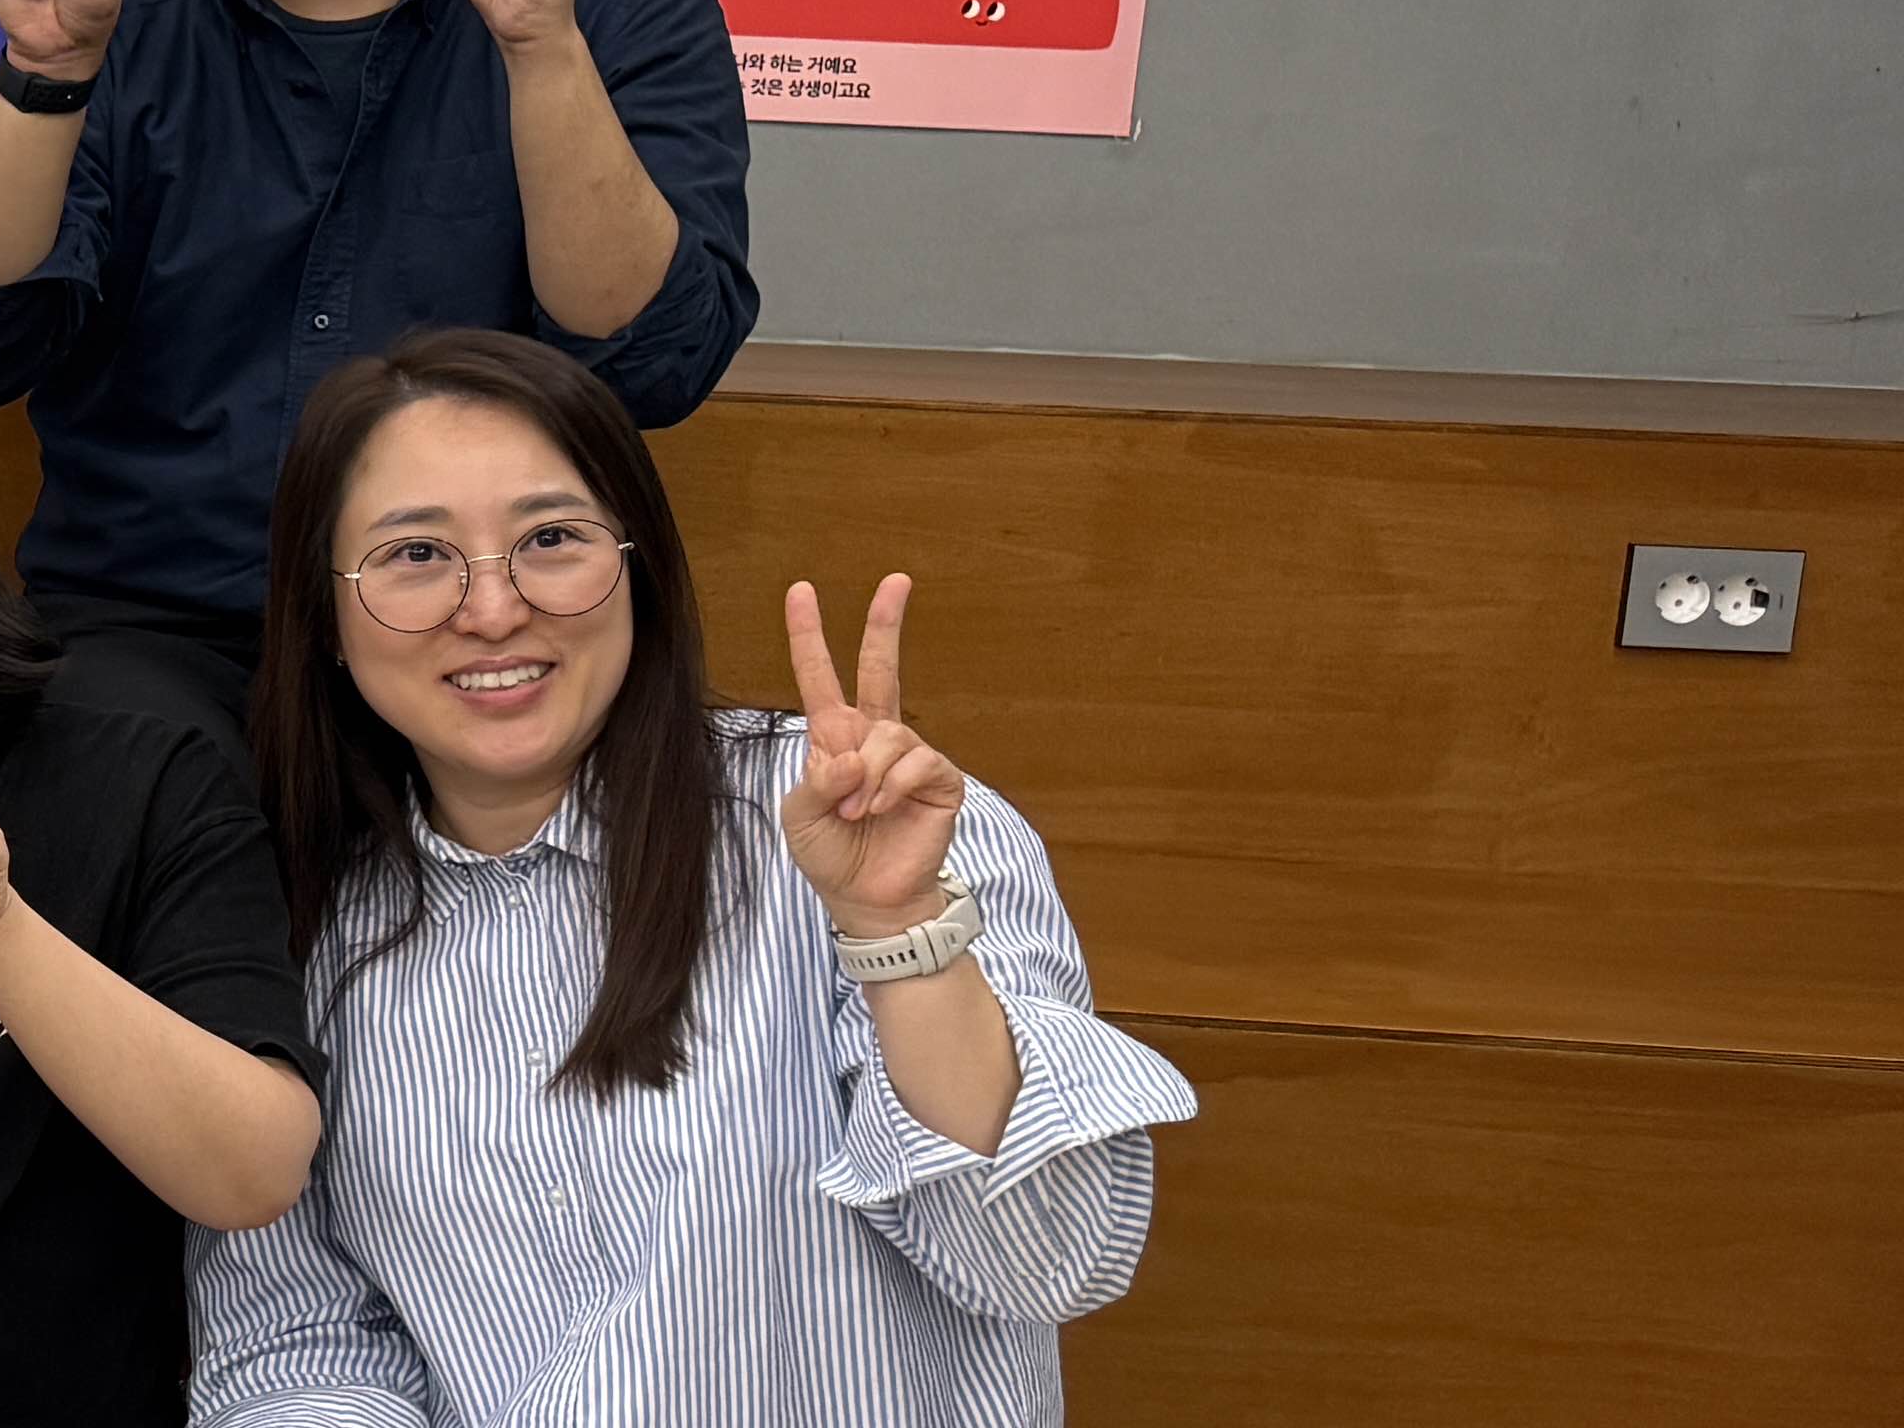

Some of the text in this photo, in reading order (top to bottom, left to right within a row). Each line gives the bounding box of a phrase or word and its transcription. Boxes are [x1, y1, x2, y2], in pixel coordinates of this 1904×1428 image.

[770, 54, 804, 72] 하는
[751, 78, 871, 98] 것은 상생이고요
